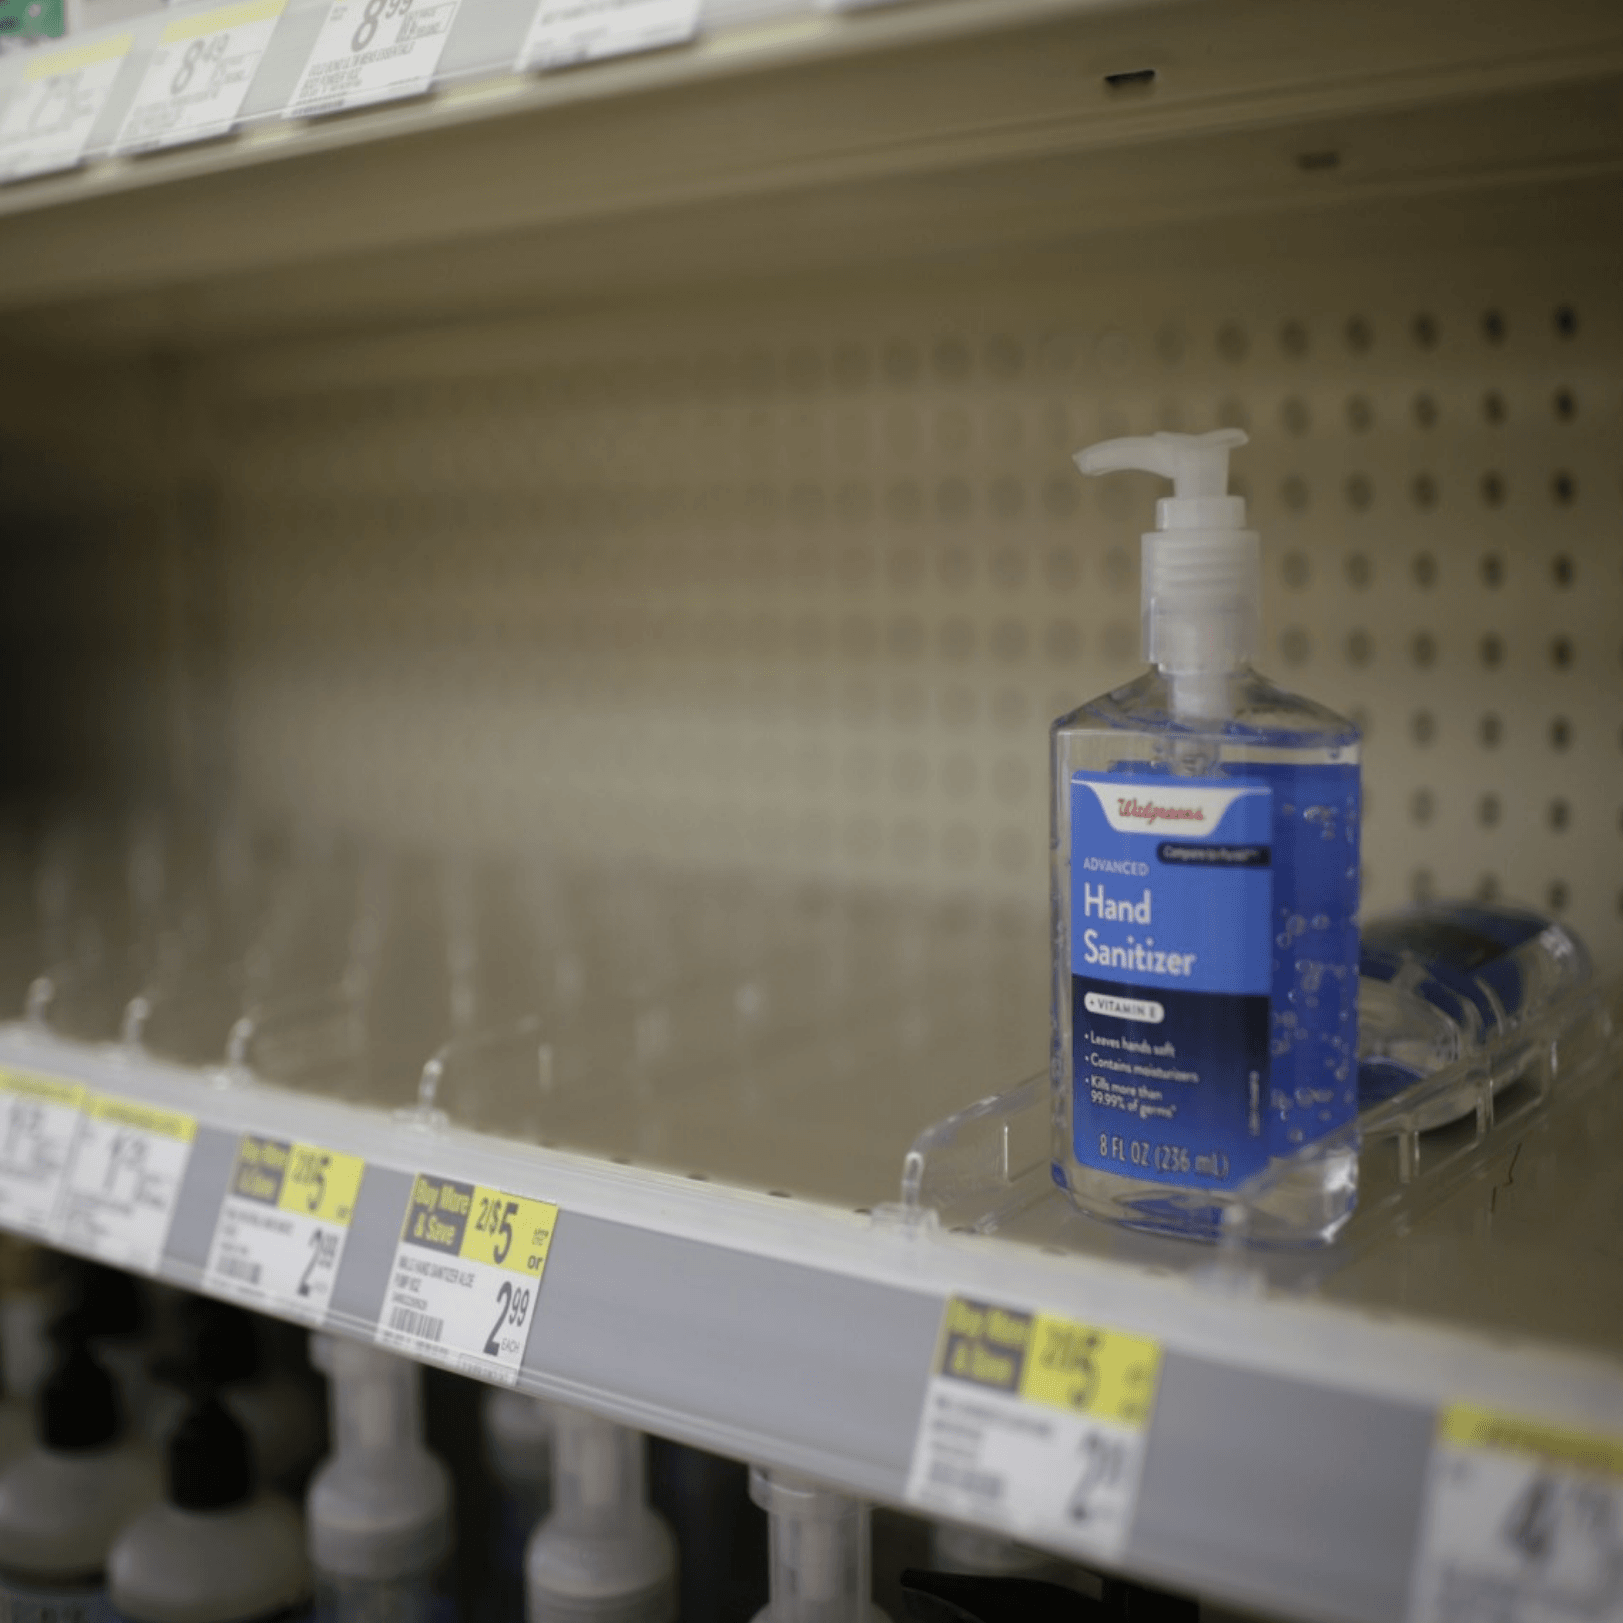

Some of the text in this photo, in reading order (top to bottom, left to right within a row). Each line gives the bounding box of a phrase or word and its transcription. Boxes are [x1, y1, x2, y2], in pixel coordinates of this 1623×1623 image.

[1117, 799, 1205, 825] Walgreens
[1082, 857, 1150, 877] ADVANCED
[1084, 882, 1152, 925] Hand
[1083, 928, 1198, 977] Sanitizer
[1097, 999, 1146, 1017] VITAMIN
[1149, 1004, 1156, 1019] E
[1090, 1031, 1121, 1050] Leaves
[1122, 1036, 1152, 1055] hands
[1090, 1053, 1200, 1084] Contains moisturizers
[1090, 1090, 1125, 1110] 99.99%
[1127, 1099, 1139, 1112] of
[1091, 1075, 1163, 1101] Kills more than
[1100, 1133, 1108, 1157] 8
[1112, 1136, 1126, 1162] FL
[1130, 1140, 1150, 1167] OZ
[1154, 1145, 1191, 1173] (236
[412, 1177, 471, 1215] Buy More
[425, 1214, 457, 1246] Save
[527, 1255, 543, 1270] or
[501, 1337, 520, 1353] EACH
